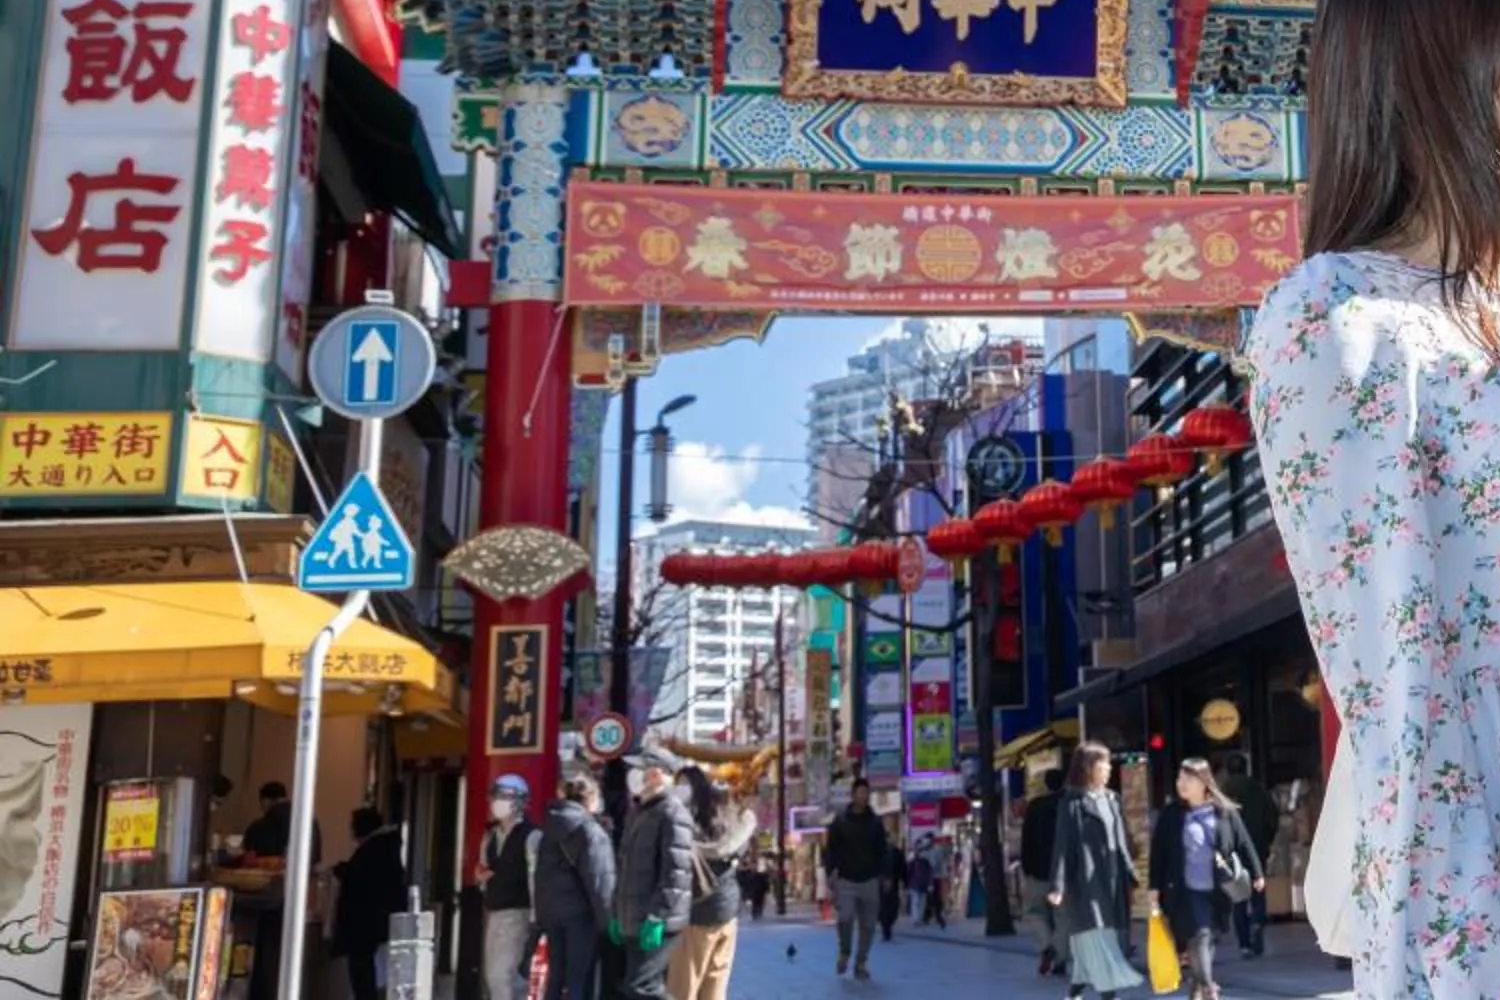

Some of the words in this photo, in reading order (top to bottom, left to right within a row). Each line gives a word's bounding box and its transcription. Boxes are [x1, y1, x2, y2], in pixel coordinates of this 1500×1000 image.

[12, 423, 161, 459] 中華街
[201, 427, 249, 490] 入口
[7, 464, 156, 488] 大通り入口
